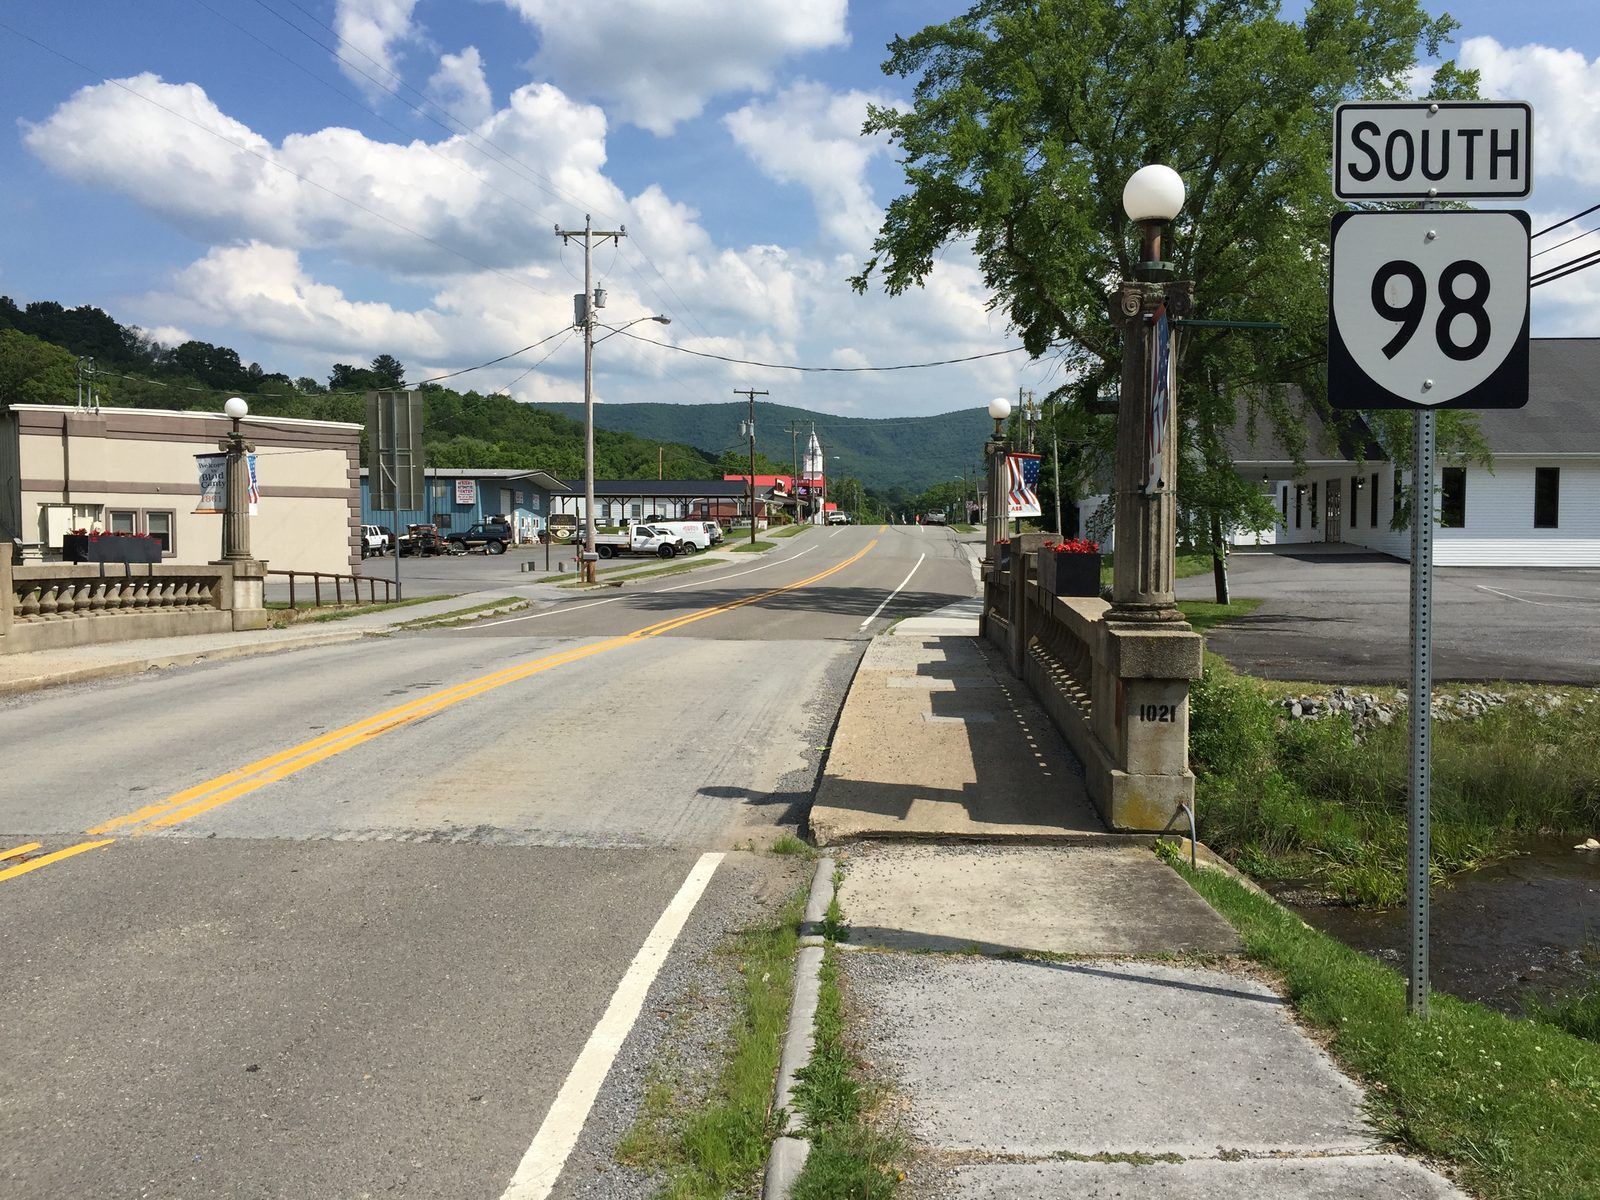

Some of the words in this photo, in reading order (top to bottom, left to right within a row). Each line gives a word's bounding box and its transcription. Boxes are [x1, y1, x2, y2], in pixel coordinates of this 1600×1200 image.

[1348, 120, 1519, 182] SOUTH
[1371, 260, 1491, 361] 98
[202, 471, 224, 481] Blnd
[1140, 704, 1176, 723] 1021
